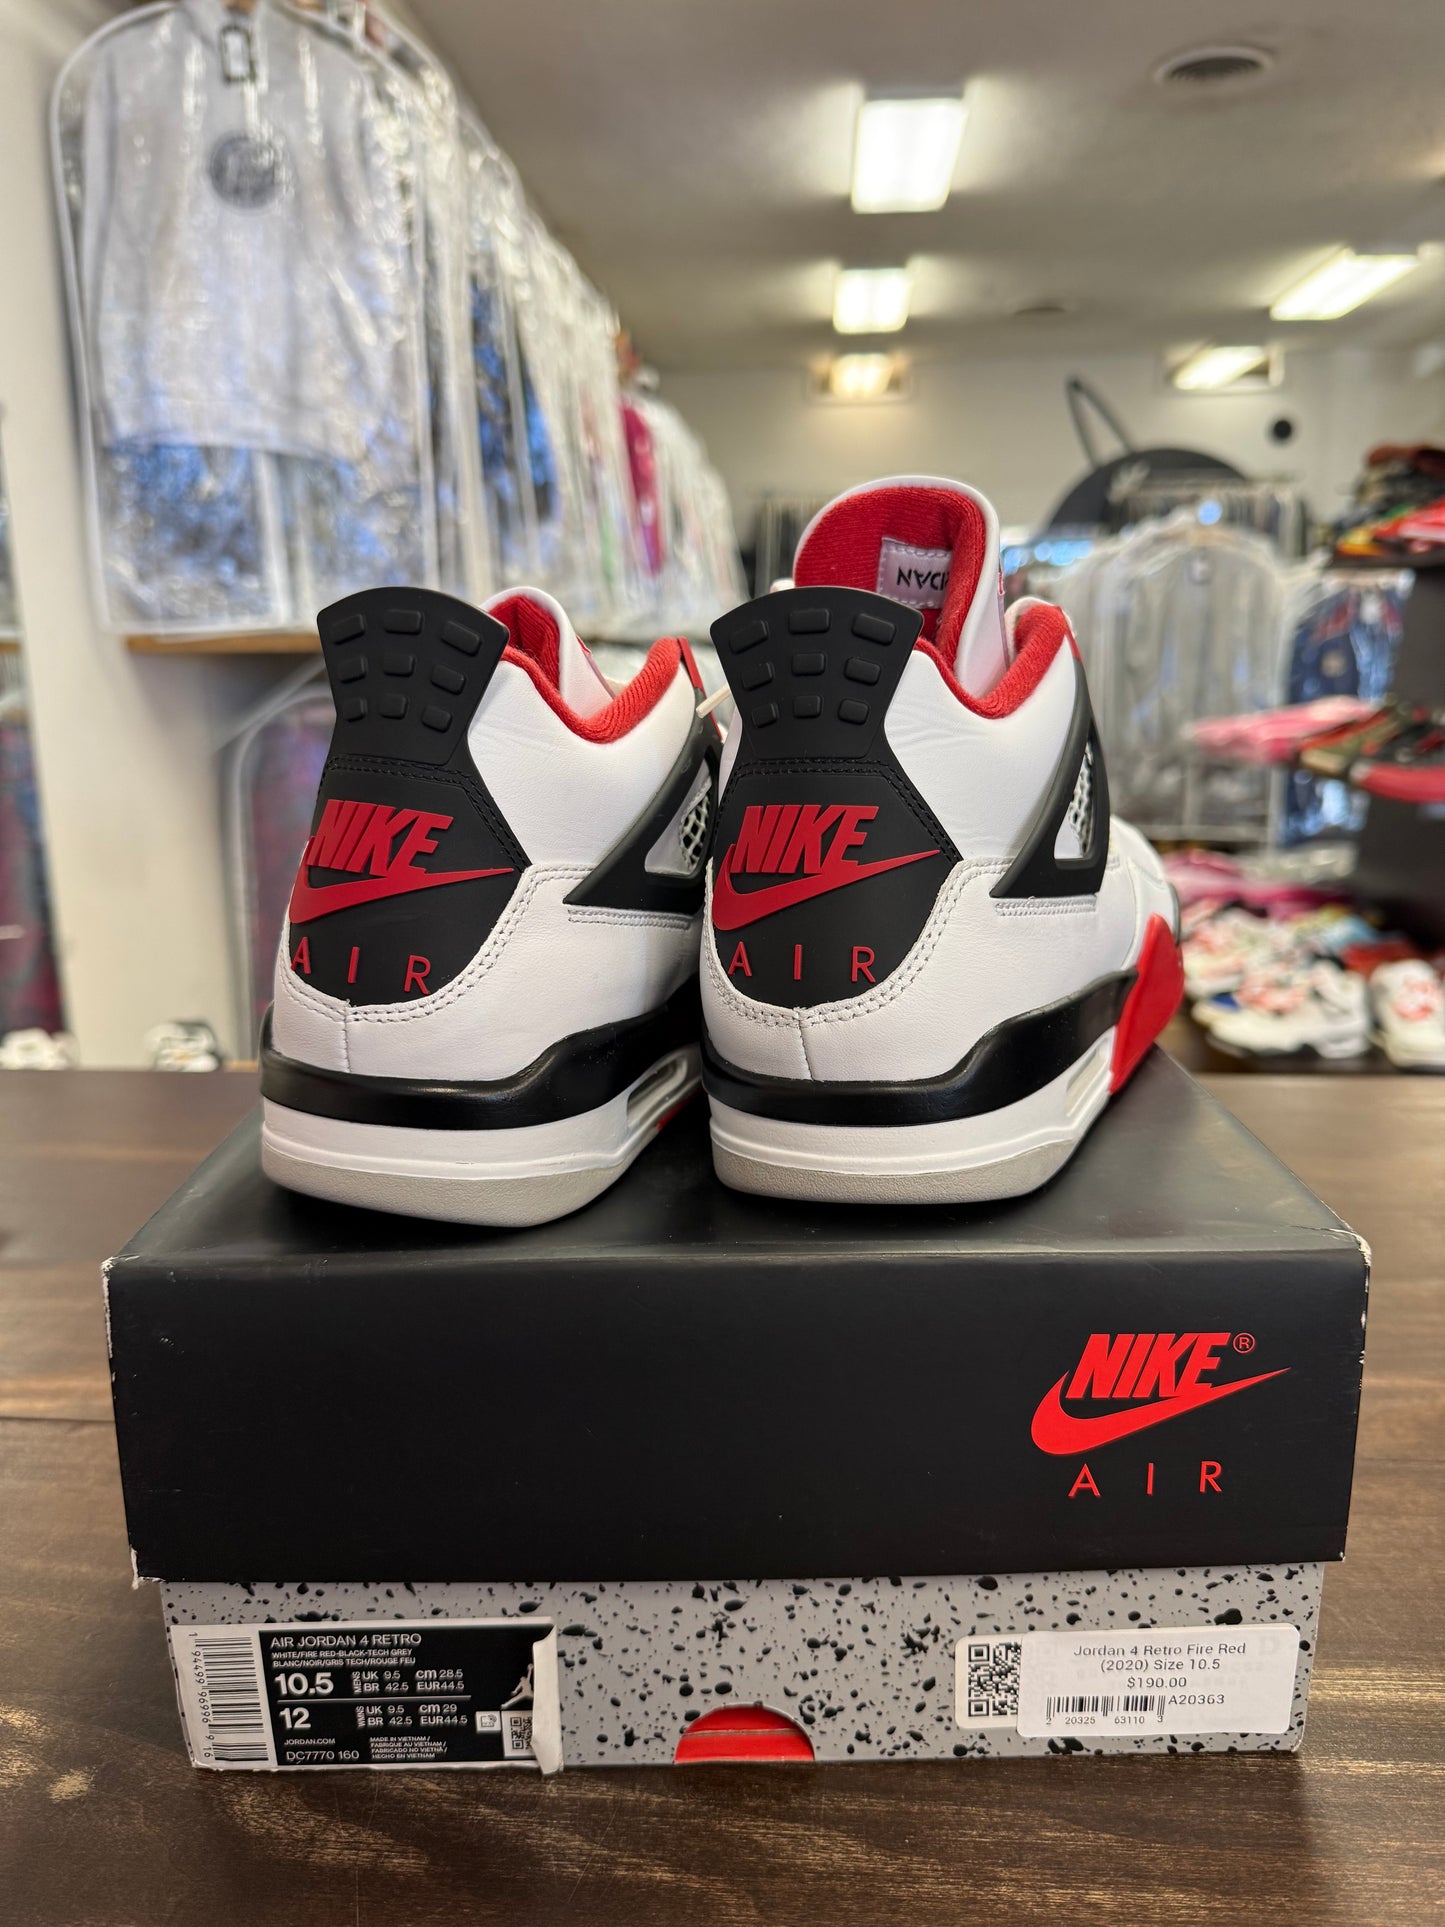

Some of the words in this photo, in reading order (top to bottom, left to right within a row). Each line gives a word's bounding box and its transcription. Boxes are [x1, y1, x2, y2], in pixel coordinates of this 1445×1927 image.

[896, 567, 950, 591] DAN
[307, 799, 454, 877] NIKE
[730, 804, 880, 875] NIKE
[291, 936, 432, 995] AIR
[727, 941, 876, 983] AIR
[1065, 1332, 1231, 1399] NIKE
[1068, 1460, 1223, 1499] AIR
[271, 1636, 294, 1648] AIR
[297, 1635, 357, 1647] JORDAN
[360, 1635, 369, 1645] 4
[372, 1633, 422, 1646] RETRO
[319, 1649, 389, 1657] RED-BLACK-TECH
[390, 1648, 412, 1656] GREY
[1074, 1645, 1125, 1656] Jordan
[1130, 1645, 1139, 1656] 4
[1143, 1644, 1182, 1656] Retro
[1186, 1643, 1213, 1655] Fire
[1218, 1643, 1246, 1654] Red
[273, 1659, 344, 1667] BLANC/NOIR/GRIS
[346, 1658, 399, 1666] TECH/ROUGE
[399, 1657, 416, 1665] FEU
[1100, 1659, 1149, 1673] (2020)
[1154, 1659, 1184, 1670] Size
[1190, 1658, 1221, 1670] 10.5
[362, 1671, 379, 1680] UK
[383, 1671, 401, 1680] 9.5
[415, 1670, 437, 1679] cm
[439, 1669, 464, 1678] 28.5
[274, 1672, 334, 1695] 10.5
[363, 1683, 380, 1692] BR
[385, 1682, 409, 1691] 42.5
[1127, 1676, 1187, 1689] $190.00
[1168, 1694, 1225, 1705] A20363
[366, 1706, 383, 1714] UK
[387, 1705, 405, 1714] 9.5
[419, 1704, 441, 1713] cm
[442, 1703, 458, 1712] 29
[279, 1707, 312, 1729] 12
[367, 1717, 384, 1726] BR
[389, 1716, 413, 1725] 42.5
[1065, 1716, 1096, 1725] 20325
[1114, 1715, 1145, 1724] 63110
[284, 1738, 336, 1746] JORDAN.COM
[286, 1750, 335, 1761] DC7770
[338, 1750, 360, 1760] 160
